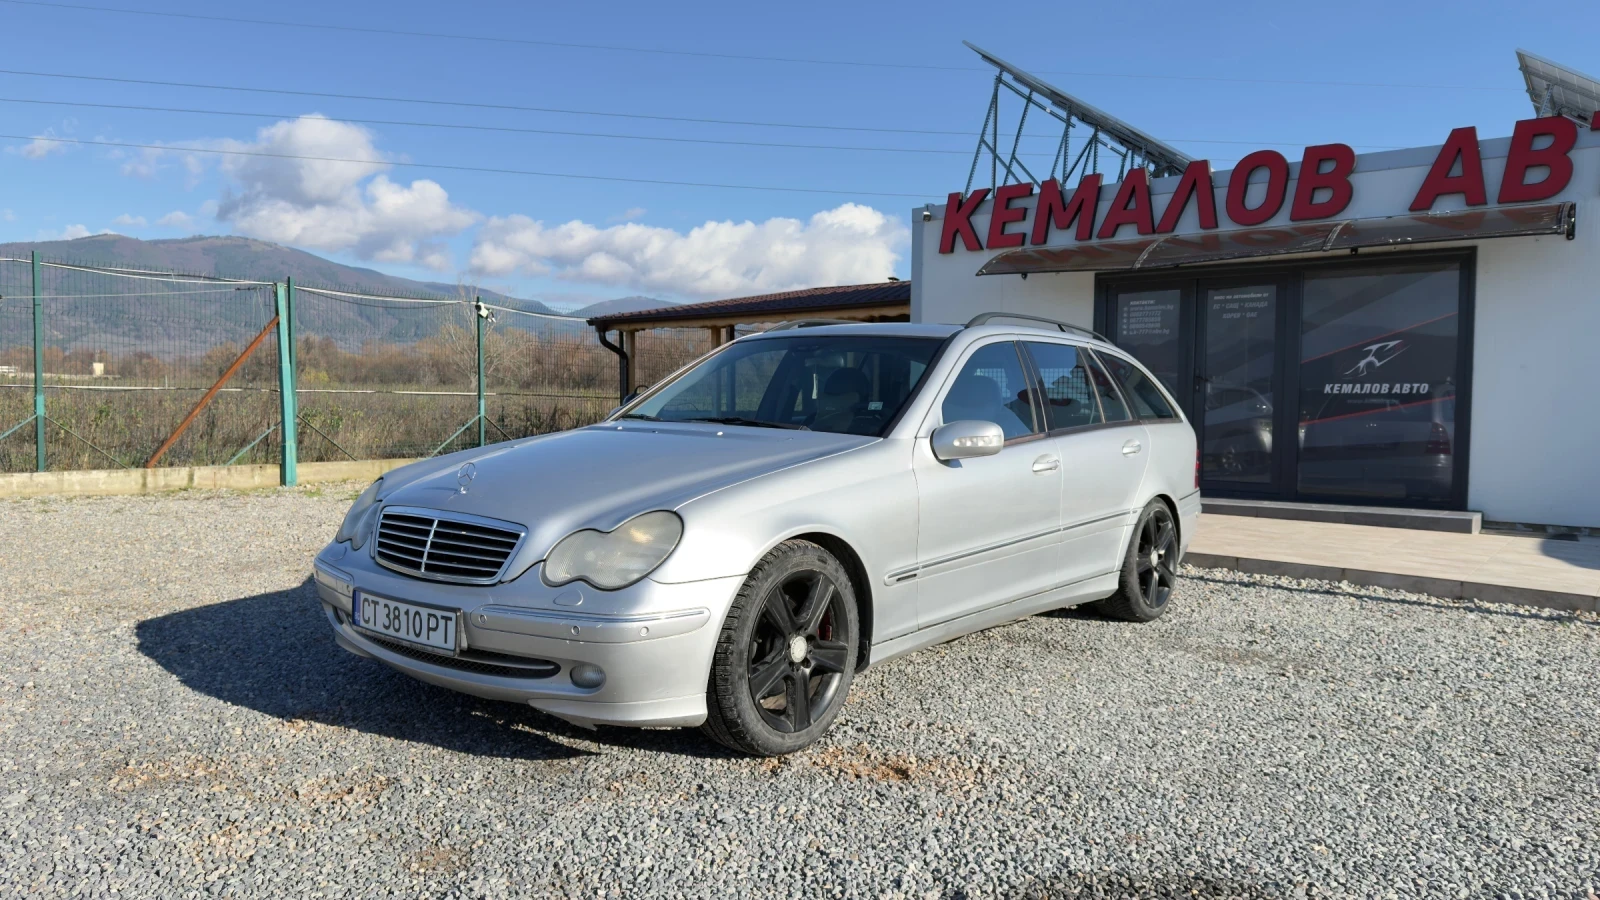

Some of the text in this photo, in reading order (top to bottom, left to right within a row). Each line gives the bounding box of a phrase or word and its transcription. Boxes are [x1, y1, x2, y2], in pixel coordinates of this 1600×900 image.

[939, 110, 1600, 254] КЕМАЛОВ АВ
[1323, 383, 1429, 394] КЕМАЛОВ АВТО
[362, 597, 453, 645] CT 3810 PT
